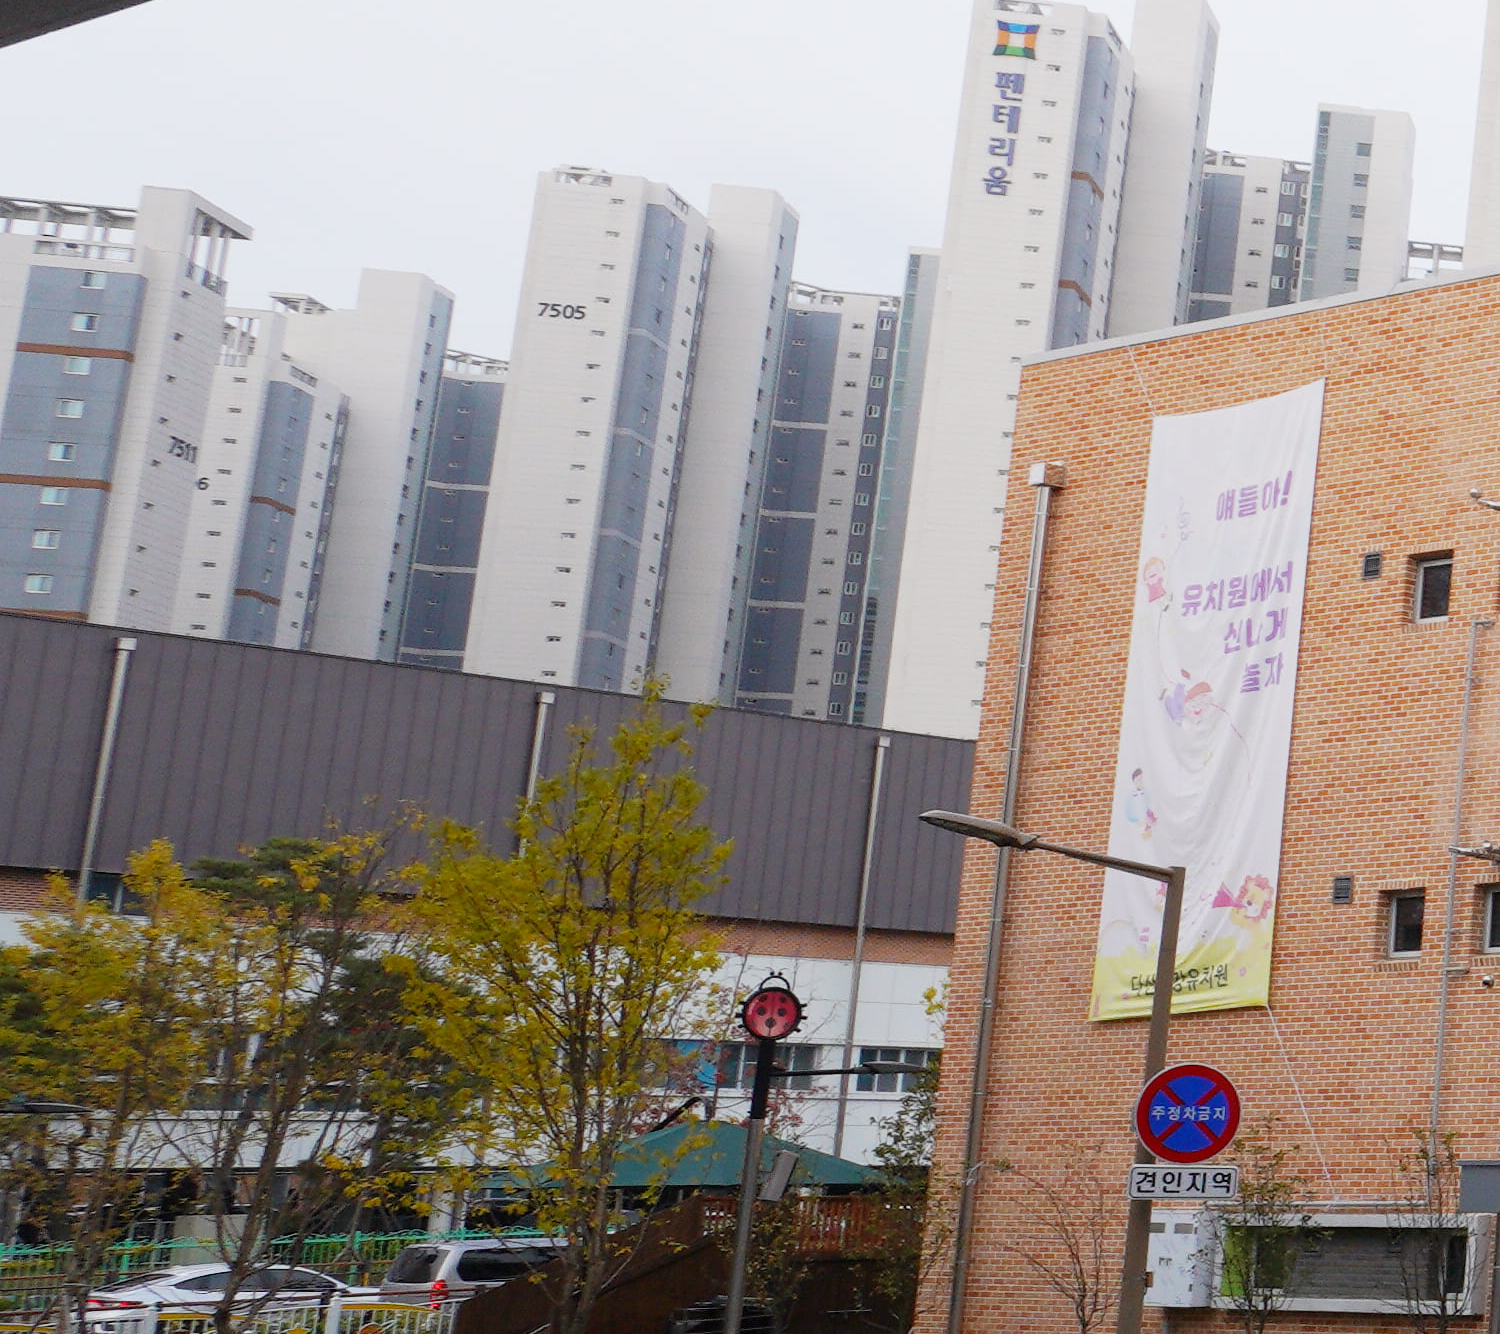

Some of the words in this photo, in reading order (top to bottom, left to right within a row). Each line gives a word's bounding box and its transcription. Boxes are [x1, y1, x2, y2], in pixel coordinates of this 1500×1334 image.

[982, 72, 1025, 196] 펜테리움
[537, 302, 586, 321] 7505
[1181, 561, 1293, 617] 유치원에서
[1224, 608, 1288, 654] 신나게
[1240, 652, 1284, 693] 놀자
[1131, 963, 1228, 997] 다산강유치원
[1151, 1105, 1226, 1121] 주정차금지
[1136, 1171, 1232, 1193] 견인지역
